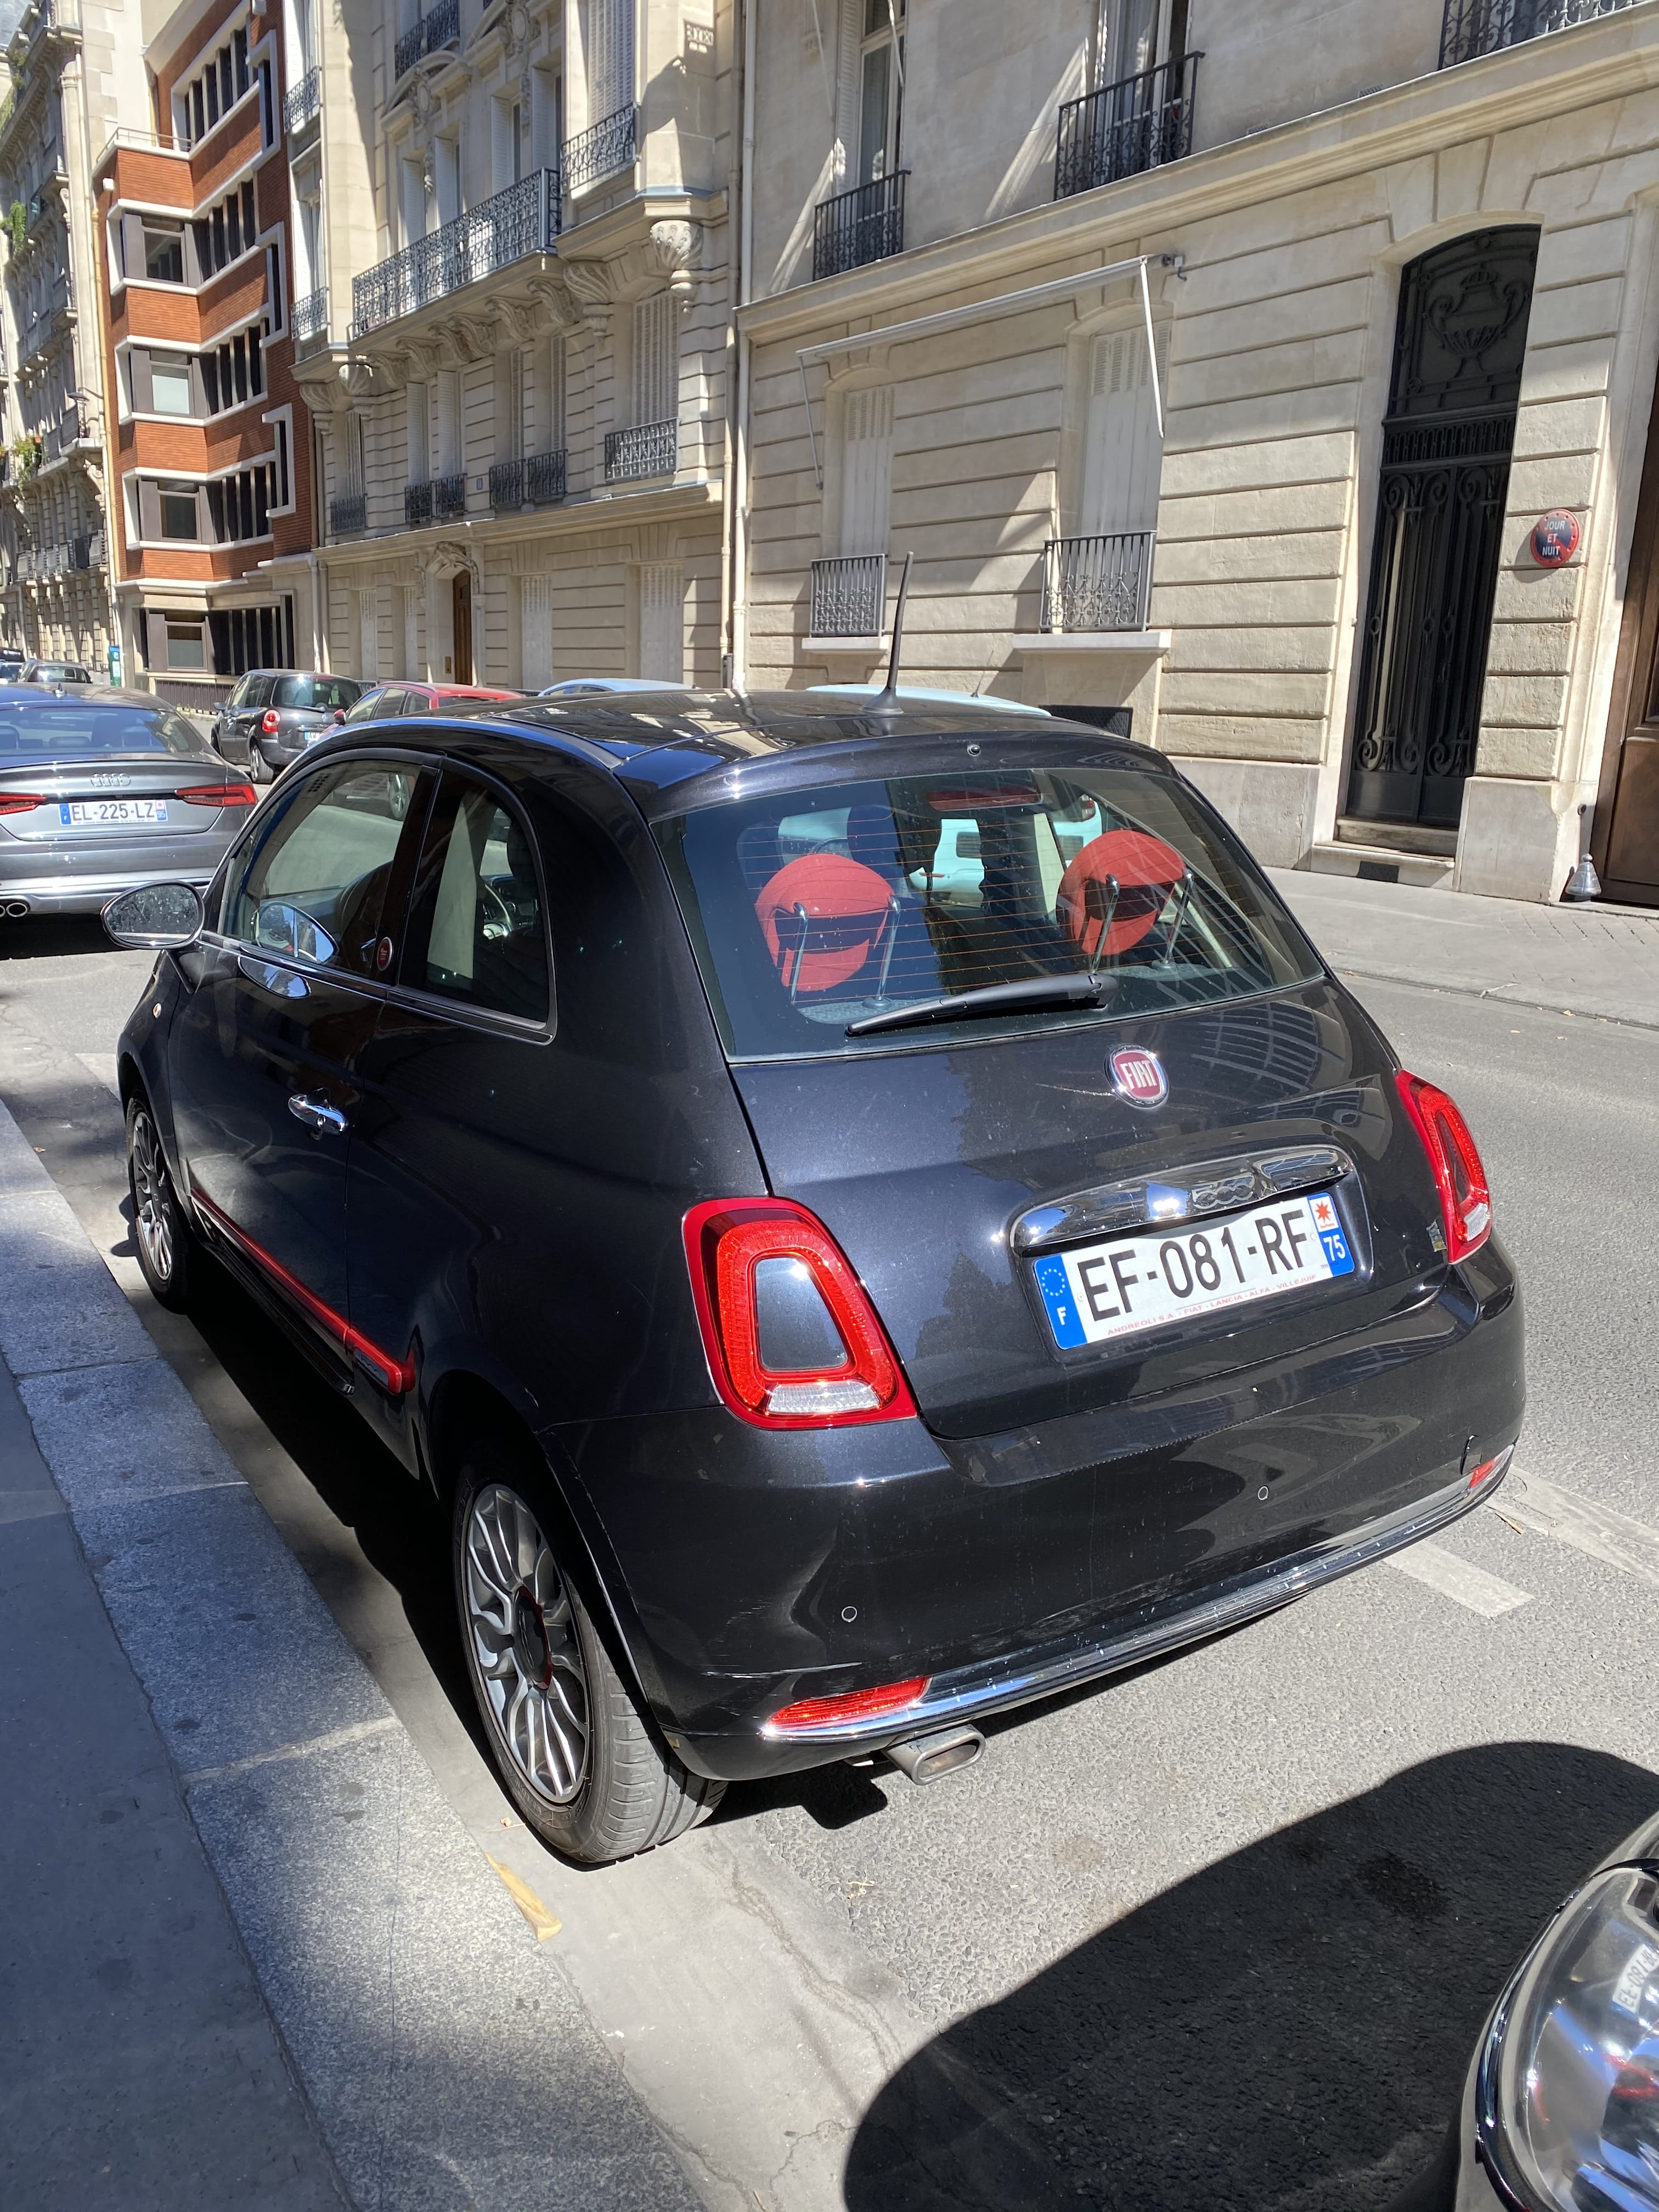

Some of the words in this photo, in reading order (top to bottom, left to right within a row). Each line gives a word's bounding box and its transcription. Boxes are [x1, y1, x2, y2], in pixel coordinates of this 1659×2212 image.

[1544, 520, 1566, 531] JOUR
[1547, 533, 1559, 543] ET
[1542, 545, 1561, 556] NUIT
[71, 802, 155, 821] EL-225-LZ
[157, 810, 166, 819] 95
[1119, 1060, 1157, 1090] FIAT
[1323, 1234, 1346, 1261] 75
[1077, 1209, 1310, 1322] EF-081-RF
[1107, 1318, 1156, 1335] ANDREOLI
[1183, 1305, 1203, 1315] FIAT
[1210, 1295, 1243, 1307] LANCIA
[1249, 1287, 1271, 1297] ALFA
[1277, 1274, 1316, 1289] VILLEJUIF
[1056, 1306, 1068, 1325] F
